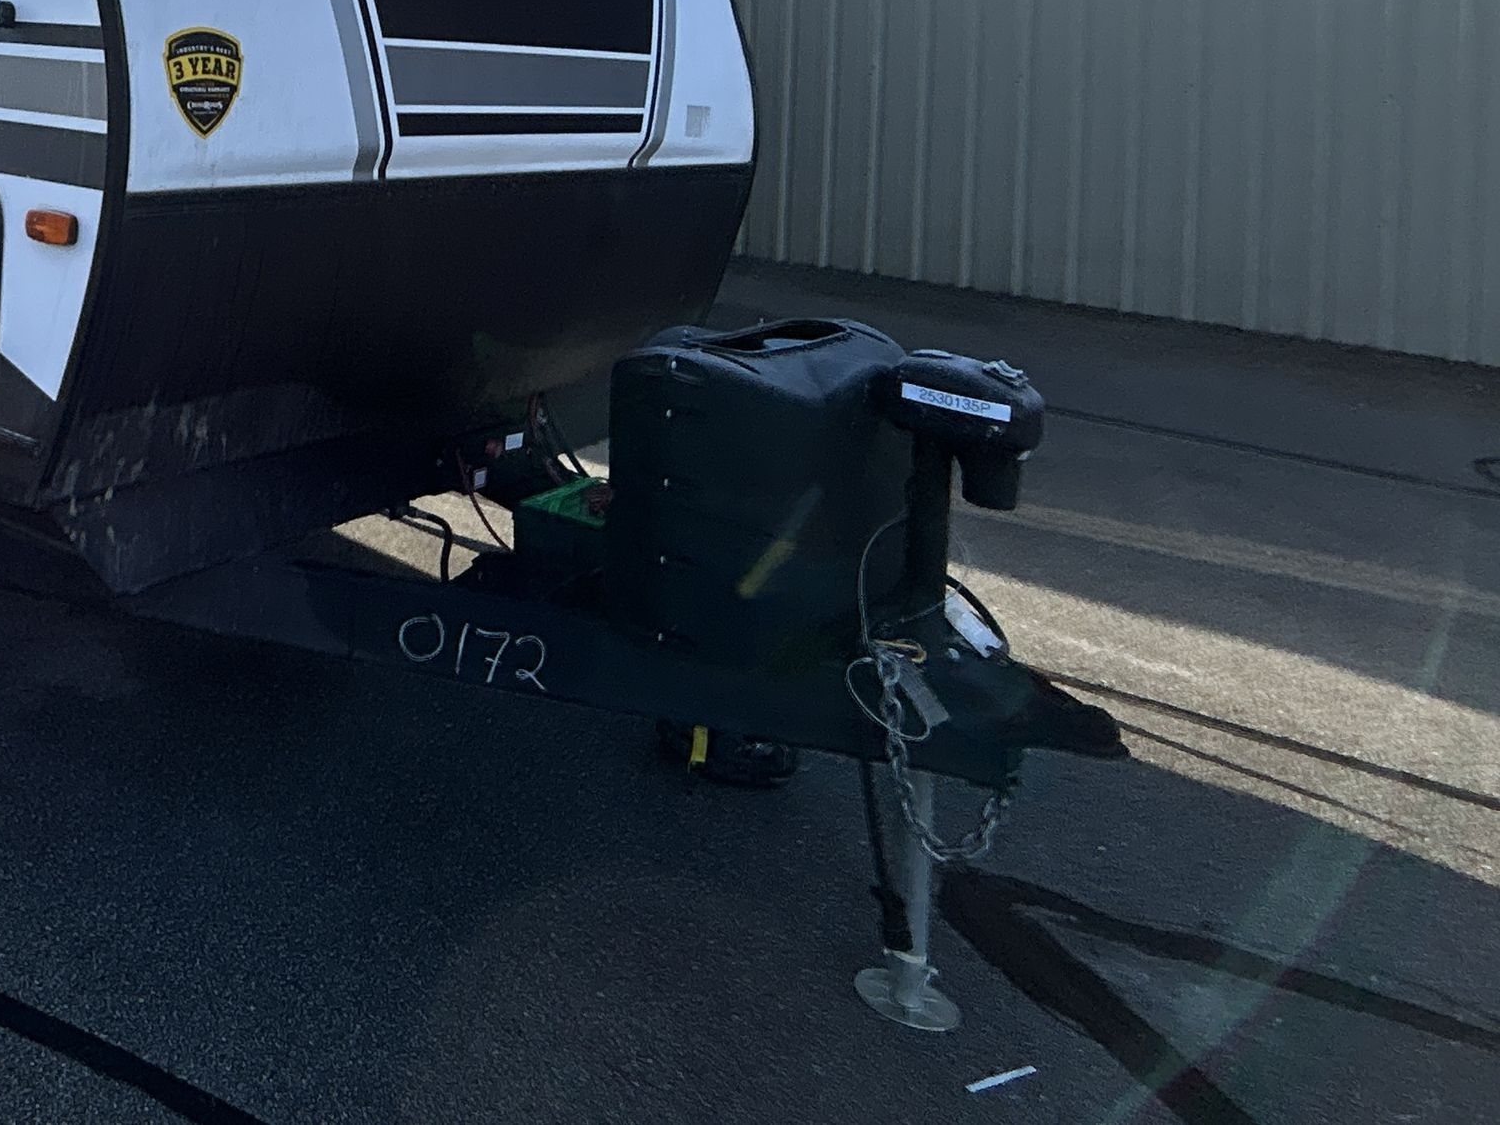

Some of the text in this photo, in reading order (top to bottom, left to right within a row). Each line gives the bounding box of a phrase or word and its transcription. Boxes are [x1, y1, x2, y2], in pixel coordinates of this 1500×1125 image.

[173, 56, 236, 80] 3 YEAR
[918, 387, 991, 414] 2530135P
